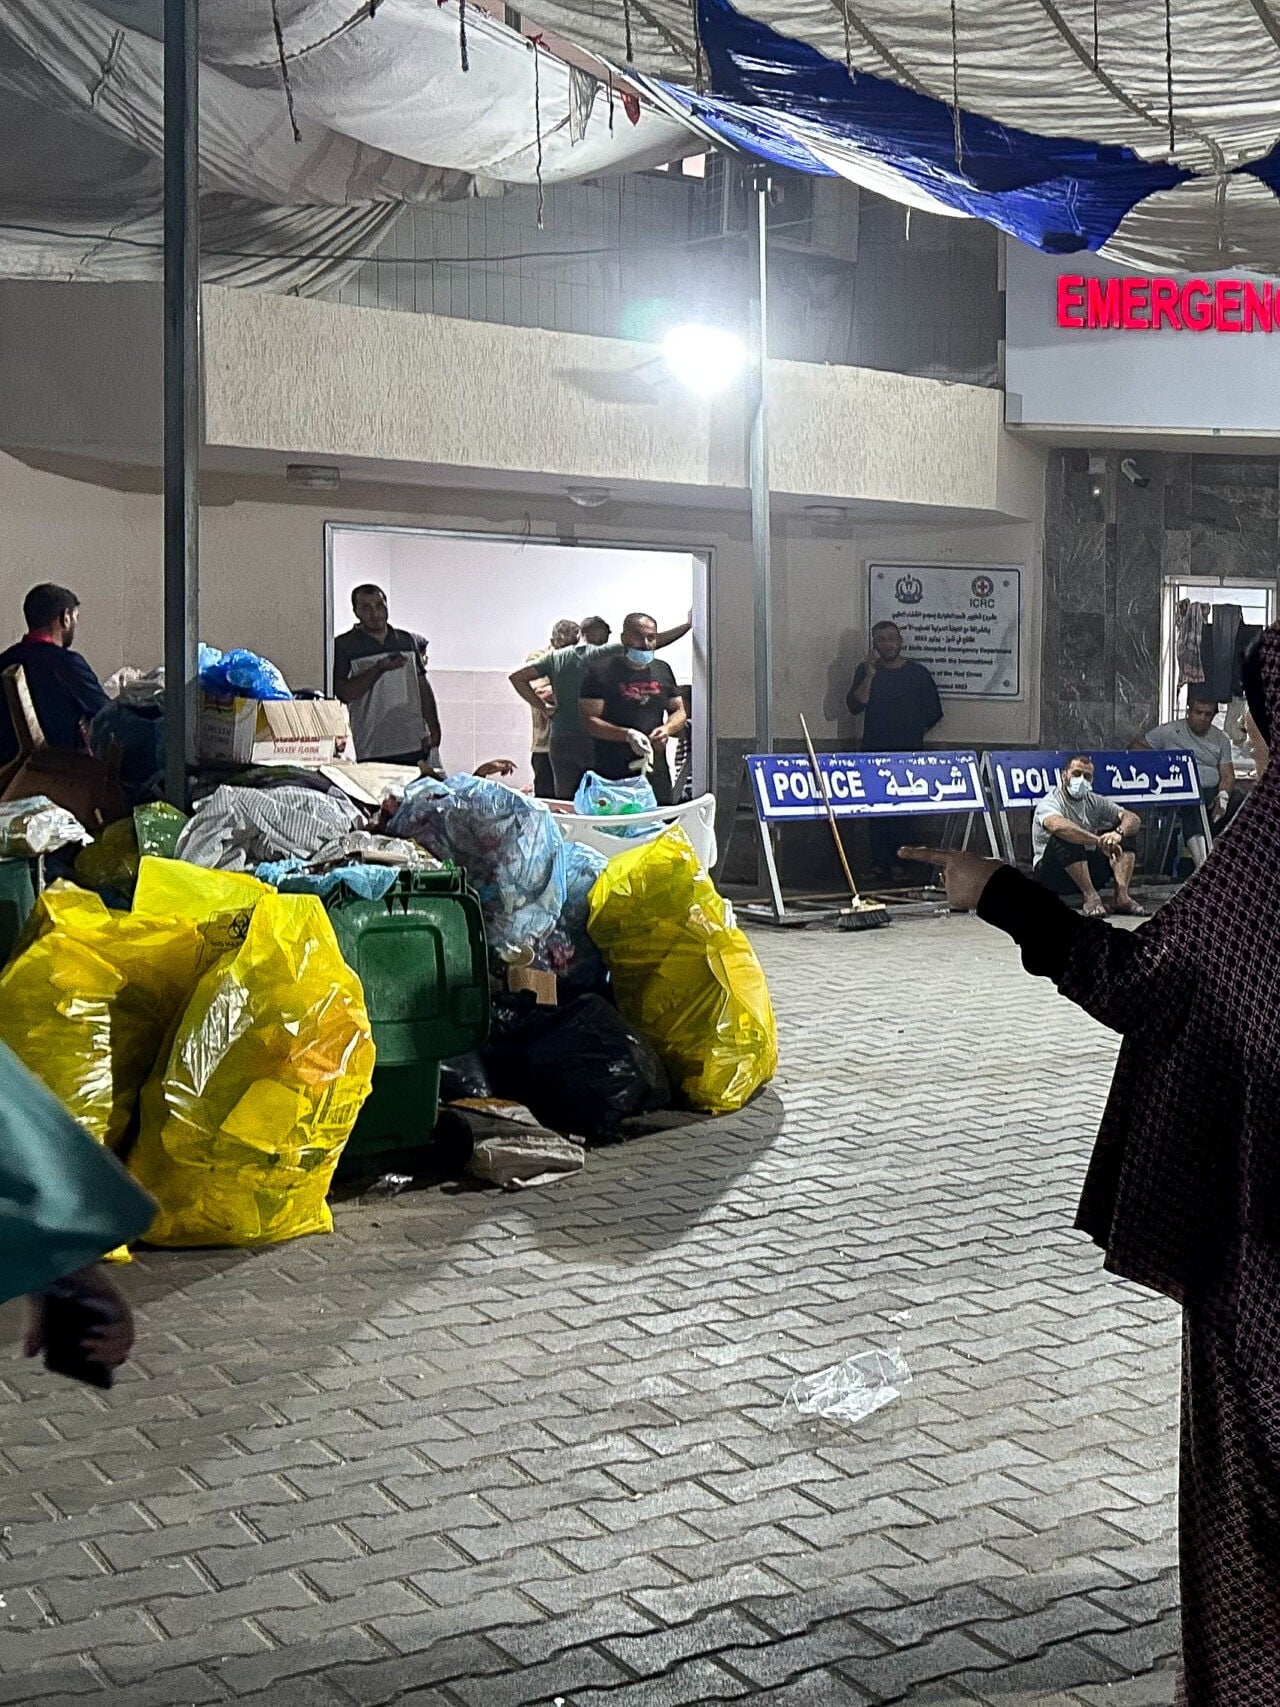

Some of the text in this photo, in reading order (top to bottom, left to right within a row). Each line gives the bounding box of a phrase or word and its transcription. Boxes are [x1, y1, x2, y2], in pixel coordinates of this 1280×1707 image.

[772, 770, 866, 801] POLICE
[877, 765, 967, 802] شرطة
[1010, 767, 1063, 794] POLI
[1105, 764, 1185, 795] شرطة
